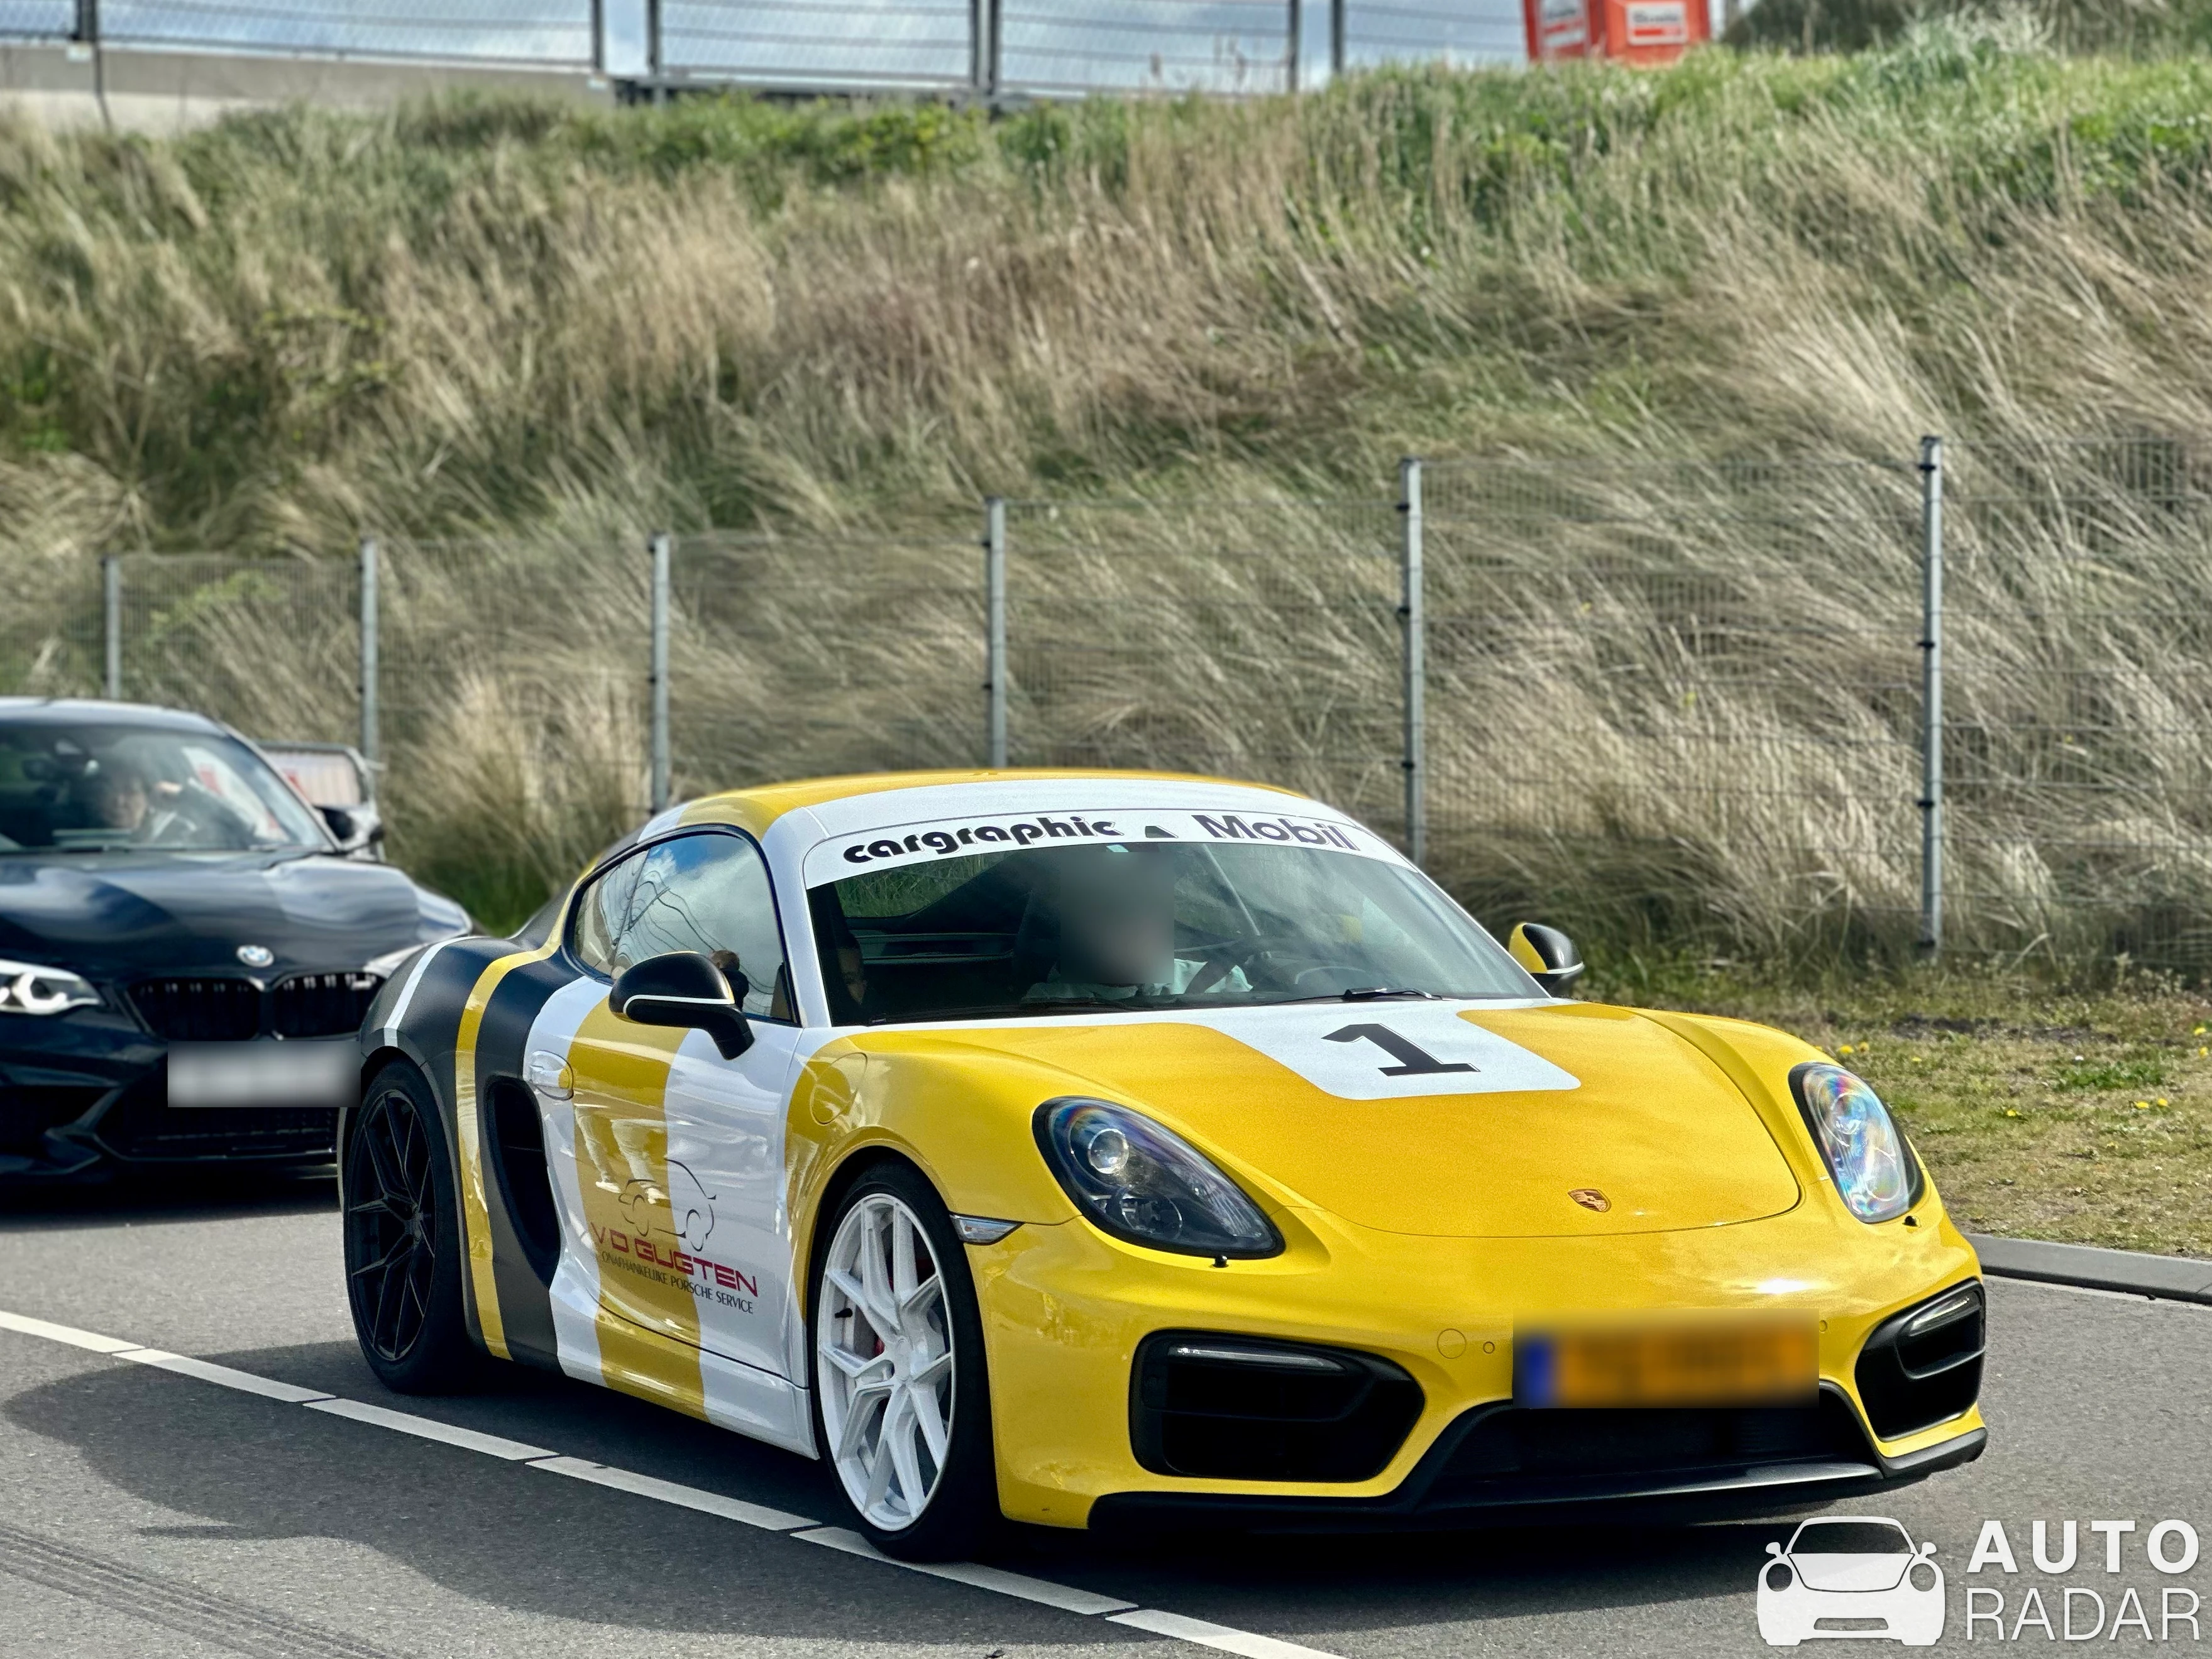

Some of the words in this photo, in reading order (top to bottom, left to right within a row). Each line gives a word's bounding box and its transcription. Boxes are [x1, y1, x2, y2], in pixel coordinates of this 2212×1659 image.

[843, 817, 1124, 863] cargraphic
[1191, 814, 1360, 851] Mobil
[1320, 1023, 1481, 1076] 1
[634, 1238, 758, 1297] GUGTEN
[670, 1274, 713, 1301] PORSCHE
[716, 1290, 754, 1315] SERVICE
